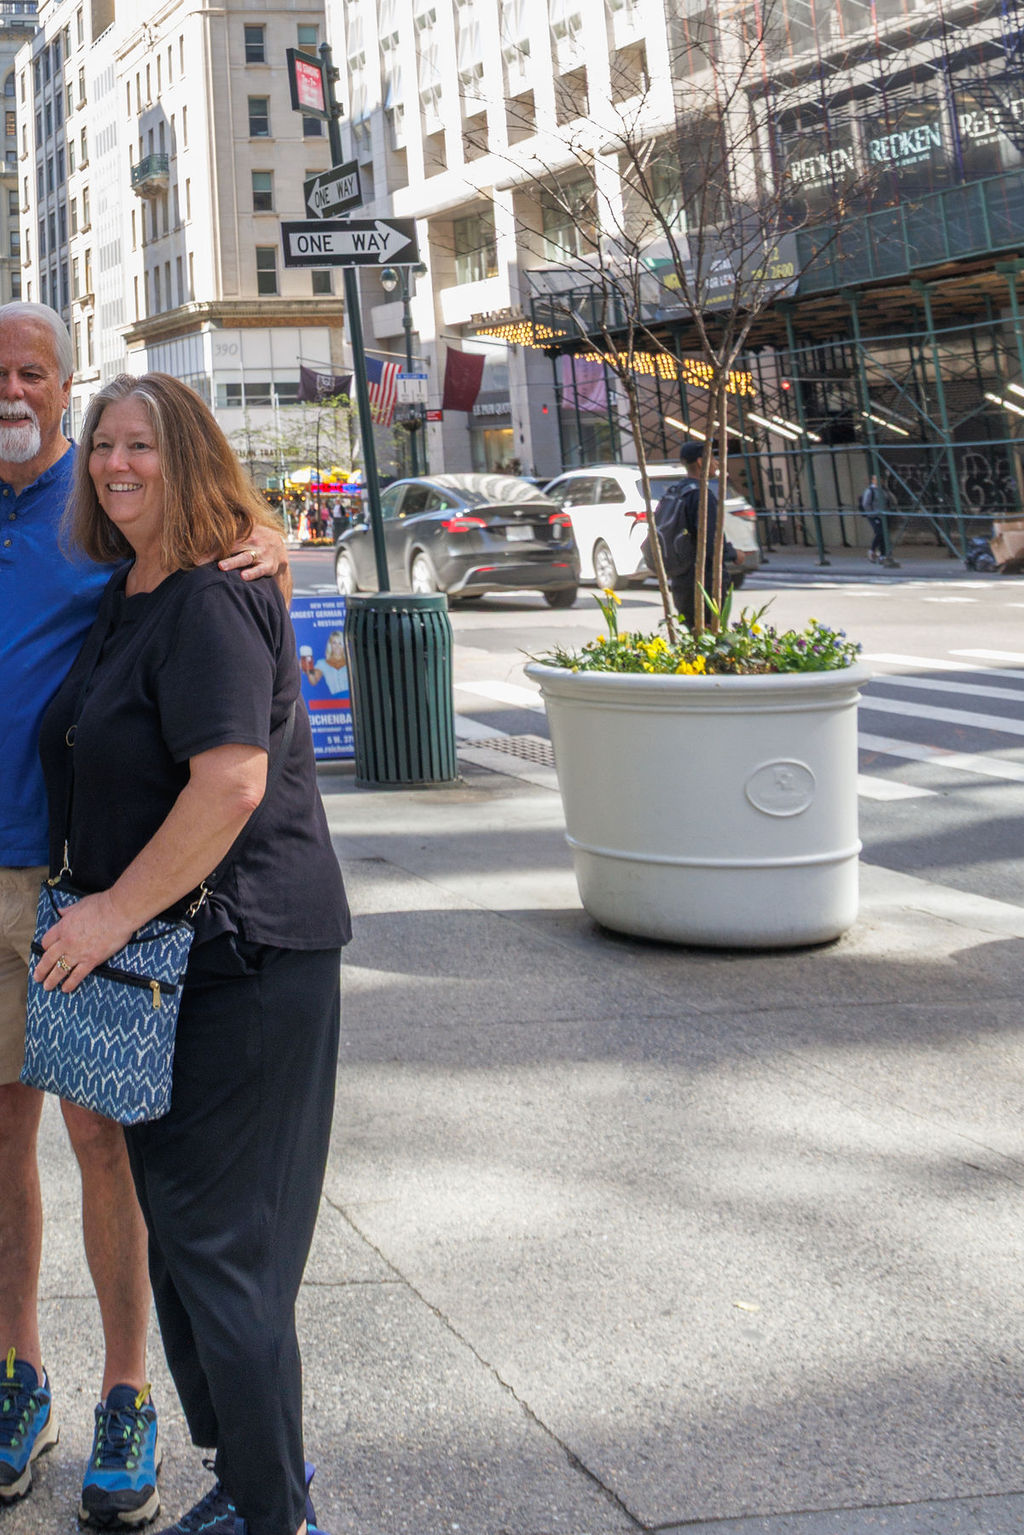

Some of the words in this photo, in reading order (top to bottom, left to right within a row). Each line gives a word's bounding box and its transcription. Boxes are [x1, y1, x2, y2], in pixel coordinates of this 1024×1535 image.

[869, 122, 942, 164] REDKEN
[791, 146, 855, 183] REDKEN
[315, 186, 330, 208] ONE
[336, 175, 354, 200] WAY
[297, 234, 334, 253] ONE
[352, 233, 390, 251] WAY
[215, 343, 239, 356] 390
[290, 610, 314, 620] ARGEST
[315, 609, 343, 619] GERMAN
[310, 713, 352, 726] EICHENBA
